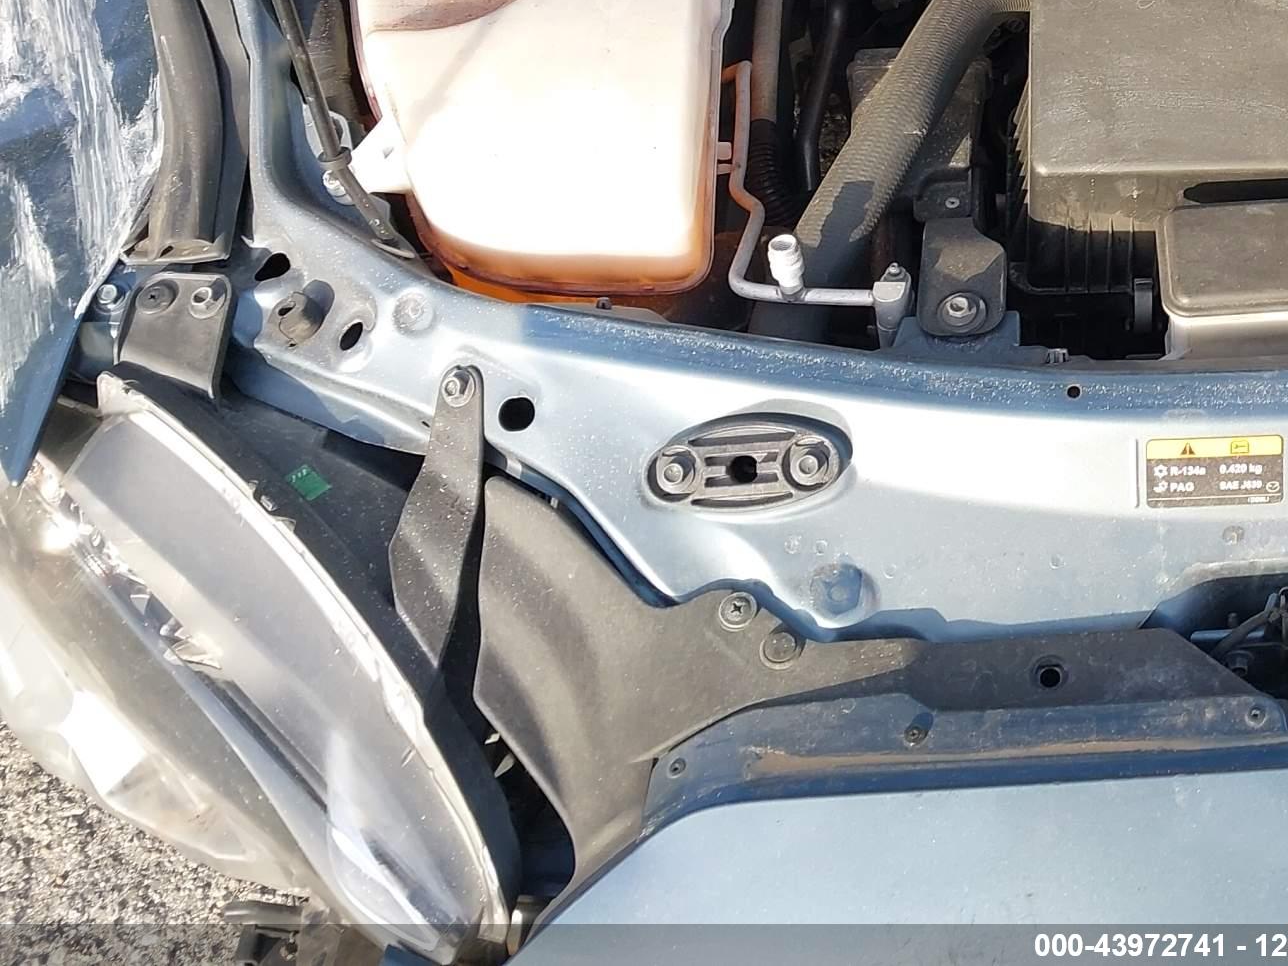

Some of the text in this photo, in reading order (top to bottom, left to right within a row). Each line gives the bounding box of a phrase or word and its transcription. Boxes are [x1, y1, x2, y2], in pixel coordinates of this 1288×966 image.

[1169, 465, 1207, 476] R-134a
[1248, 463, 1264, 475] kg
[1169, 481, 1195, 492] PAG
[1219, 480, 1240, 491] SAE
